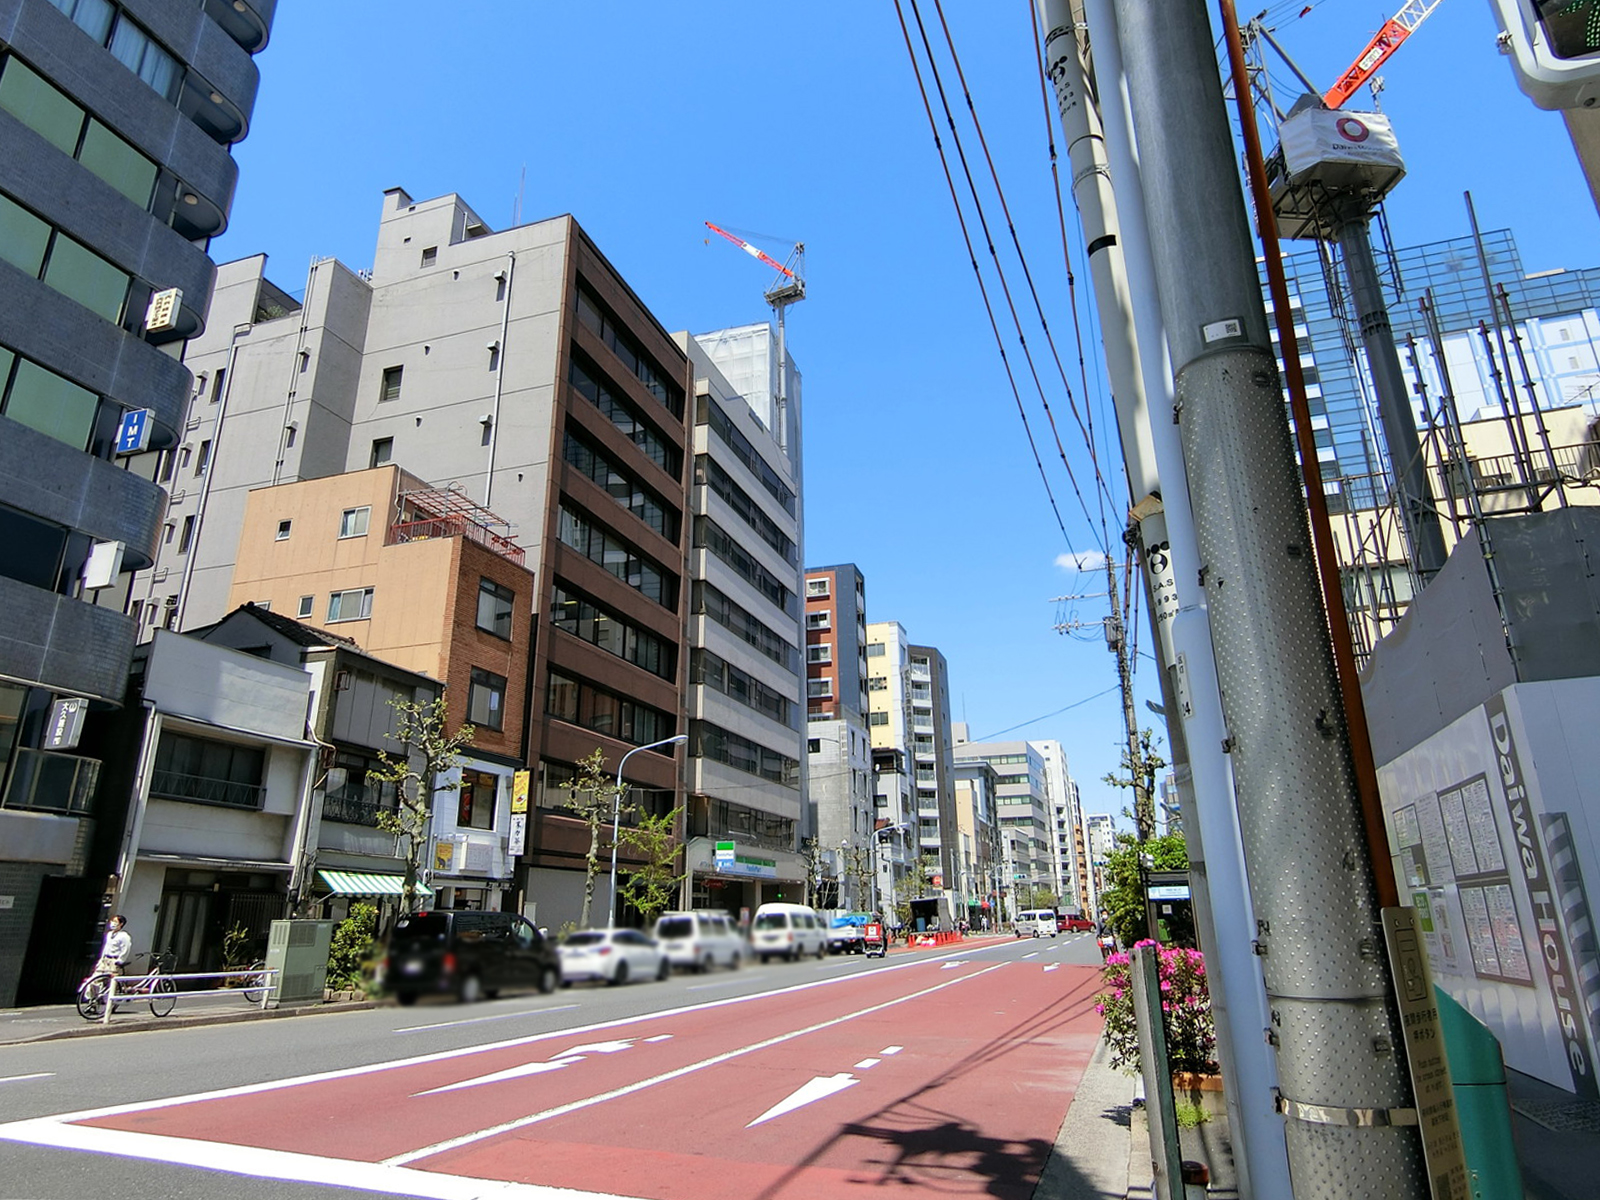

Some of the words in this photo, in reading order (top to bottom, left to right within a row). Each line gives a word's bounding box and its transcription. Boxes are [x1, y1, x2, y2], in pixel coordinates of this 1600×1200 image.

[127, 413, 138, 448] IMT
[1490, 711, 1538, 880] Daiwa
[1532, 890, 1586, 1077] House
